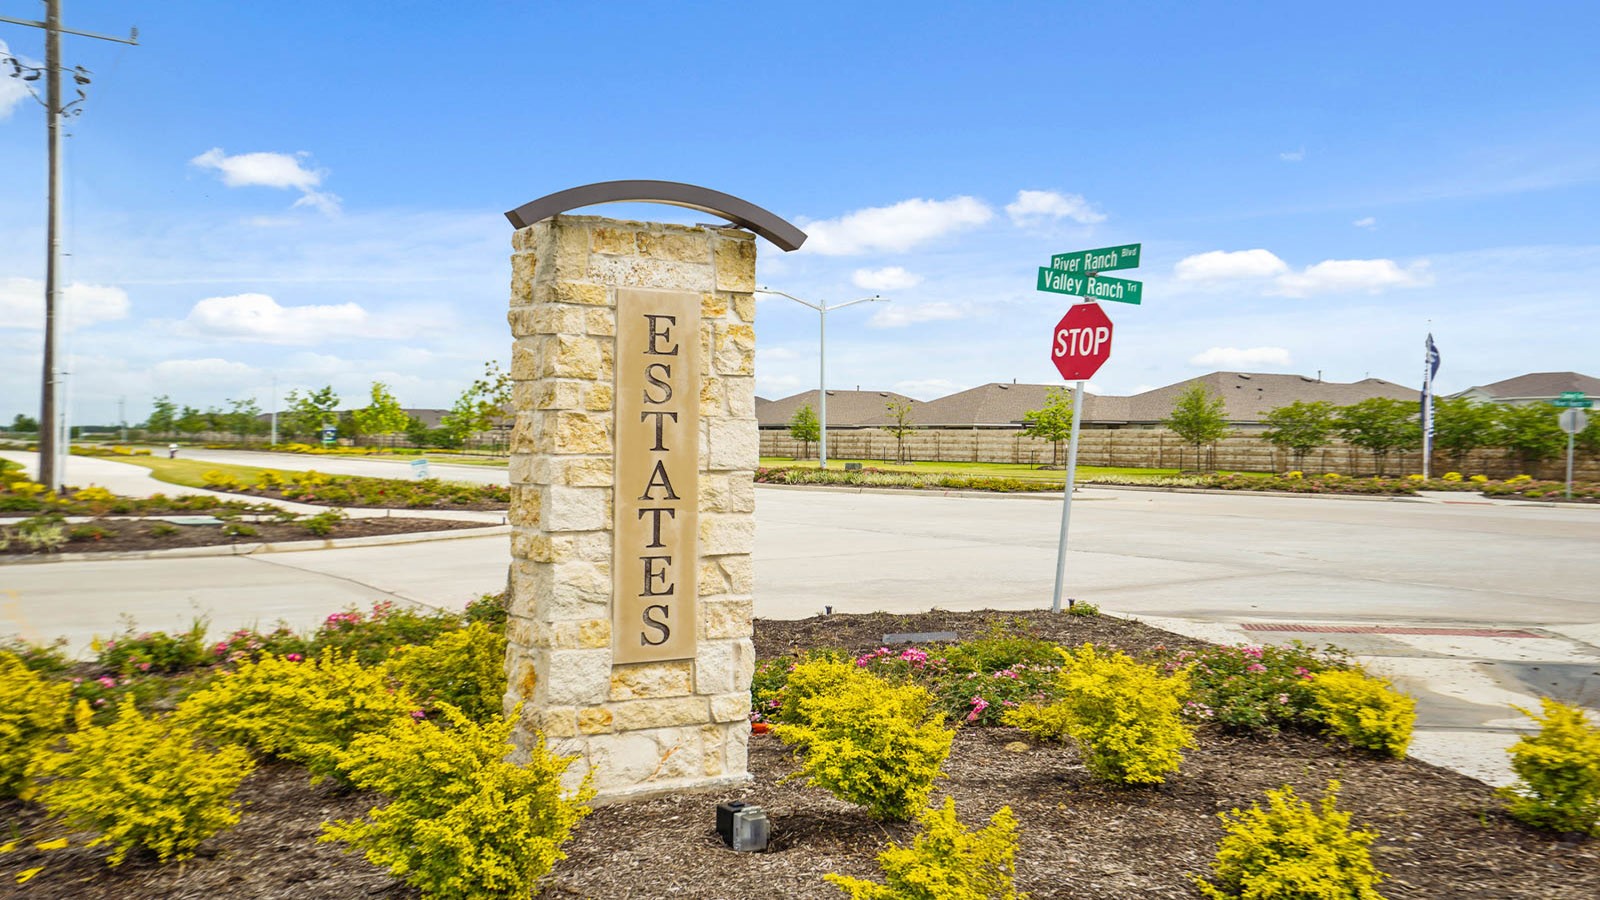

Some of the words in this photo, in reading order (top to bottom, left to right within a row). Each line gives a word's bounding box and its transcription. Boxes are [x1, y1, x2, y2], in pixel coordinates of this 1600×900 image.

[1053, 256, 1081, 272] River
[1084, 250, 1118, 271] Ranch
[1121, 247, 1137, 258] Blvd
[1044, 270, 1083, 295] Valley
[1086, 277, 1124, 299] Ranch
[1054, 326, 1110, 358] STOP
[638, 313, 681, 646] ESTATES
